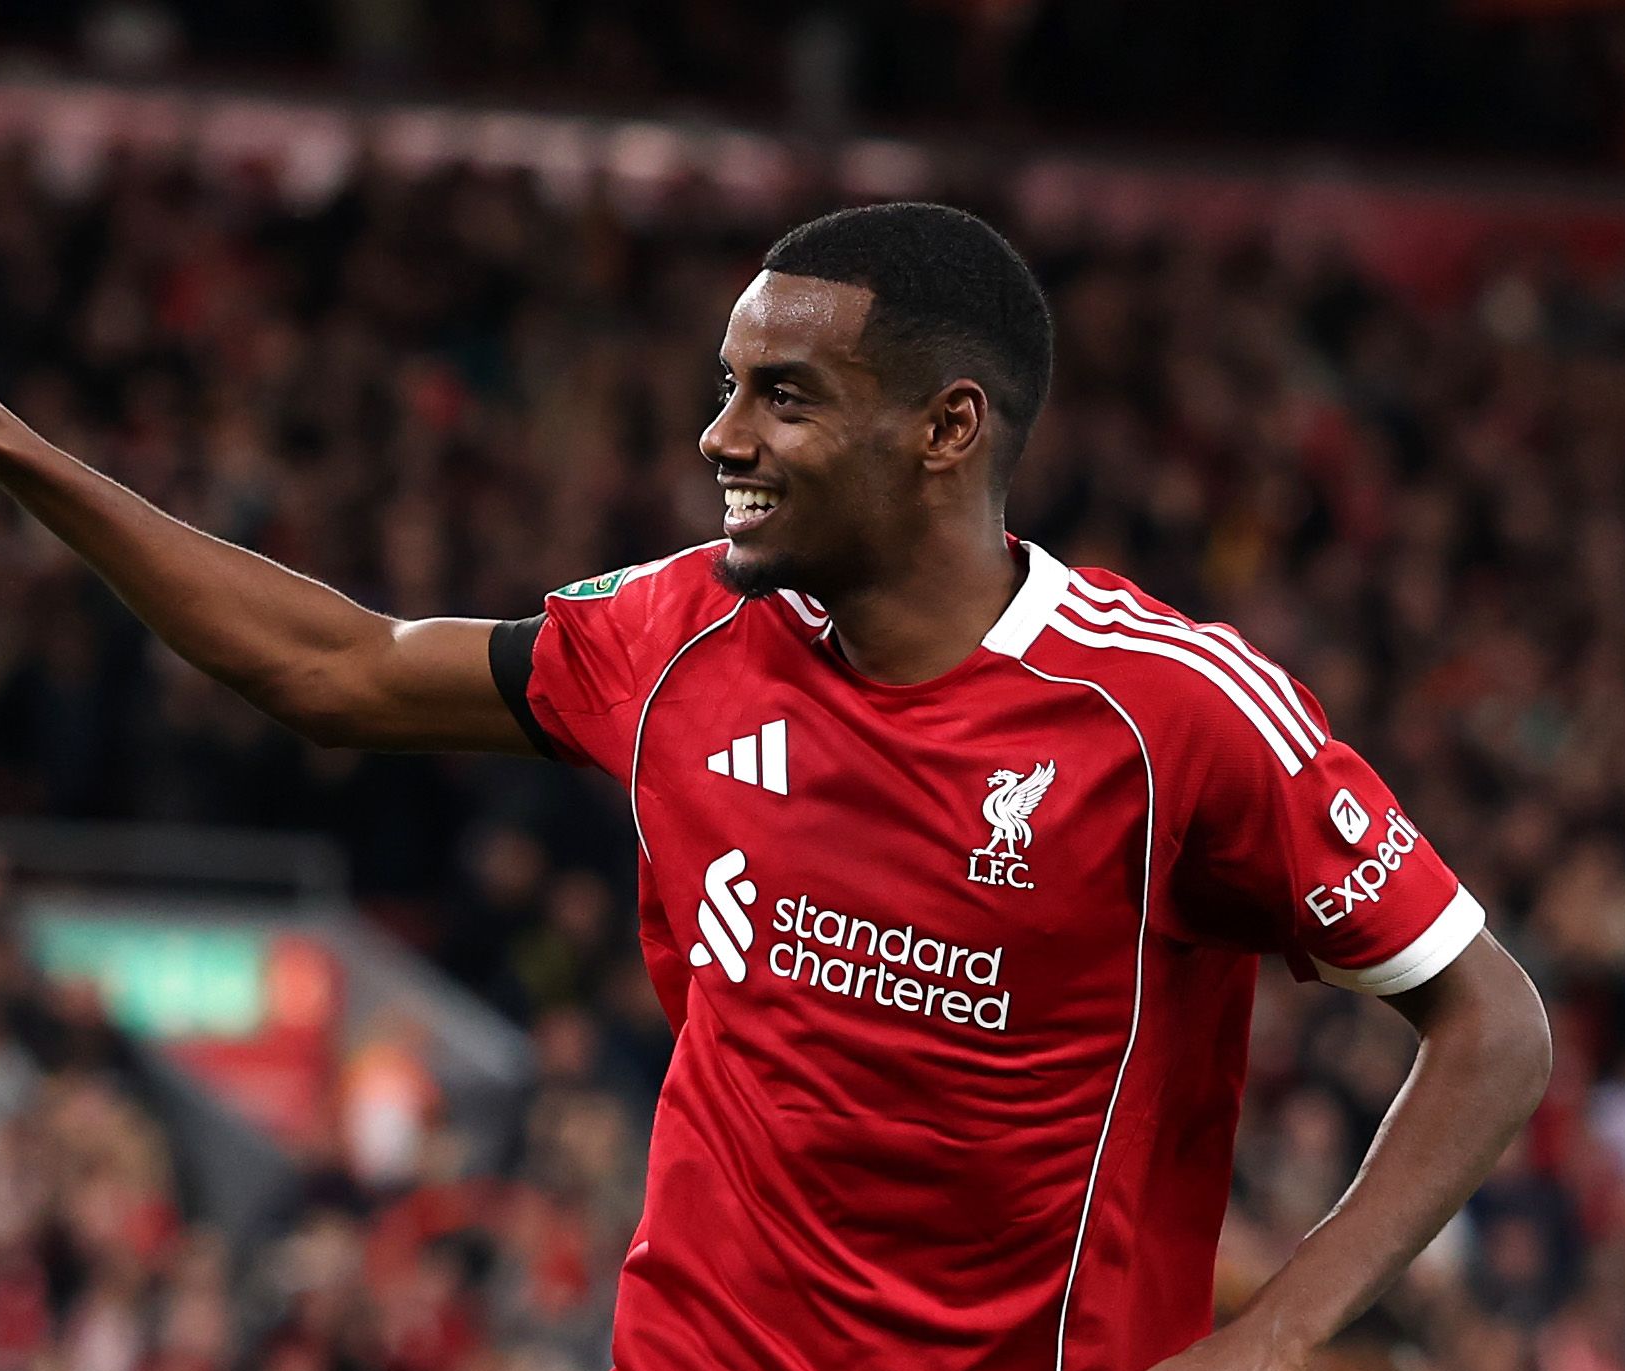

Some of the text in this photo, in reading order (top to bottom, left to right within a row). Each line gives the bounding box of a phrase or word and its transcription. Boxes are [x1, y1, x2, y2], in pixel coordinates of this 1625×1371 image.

[967, 856, 1035, 890] L.F.C.
[1304, 807, 1420, 927] Expedi
[774, 897, 1004, 987] standard
[769, 942, 1010, 1033] chartered
